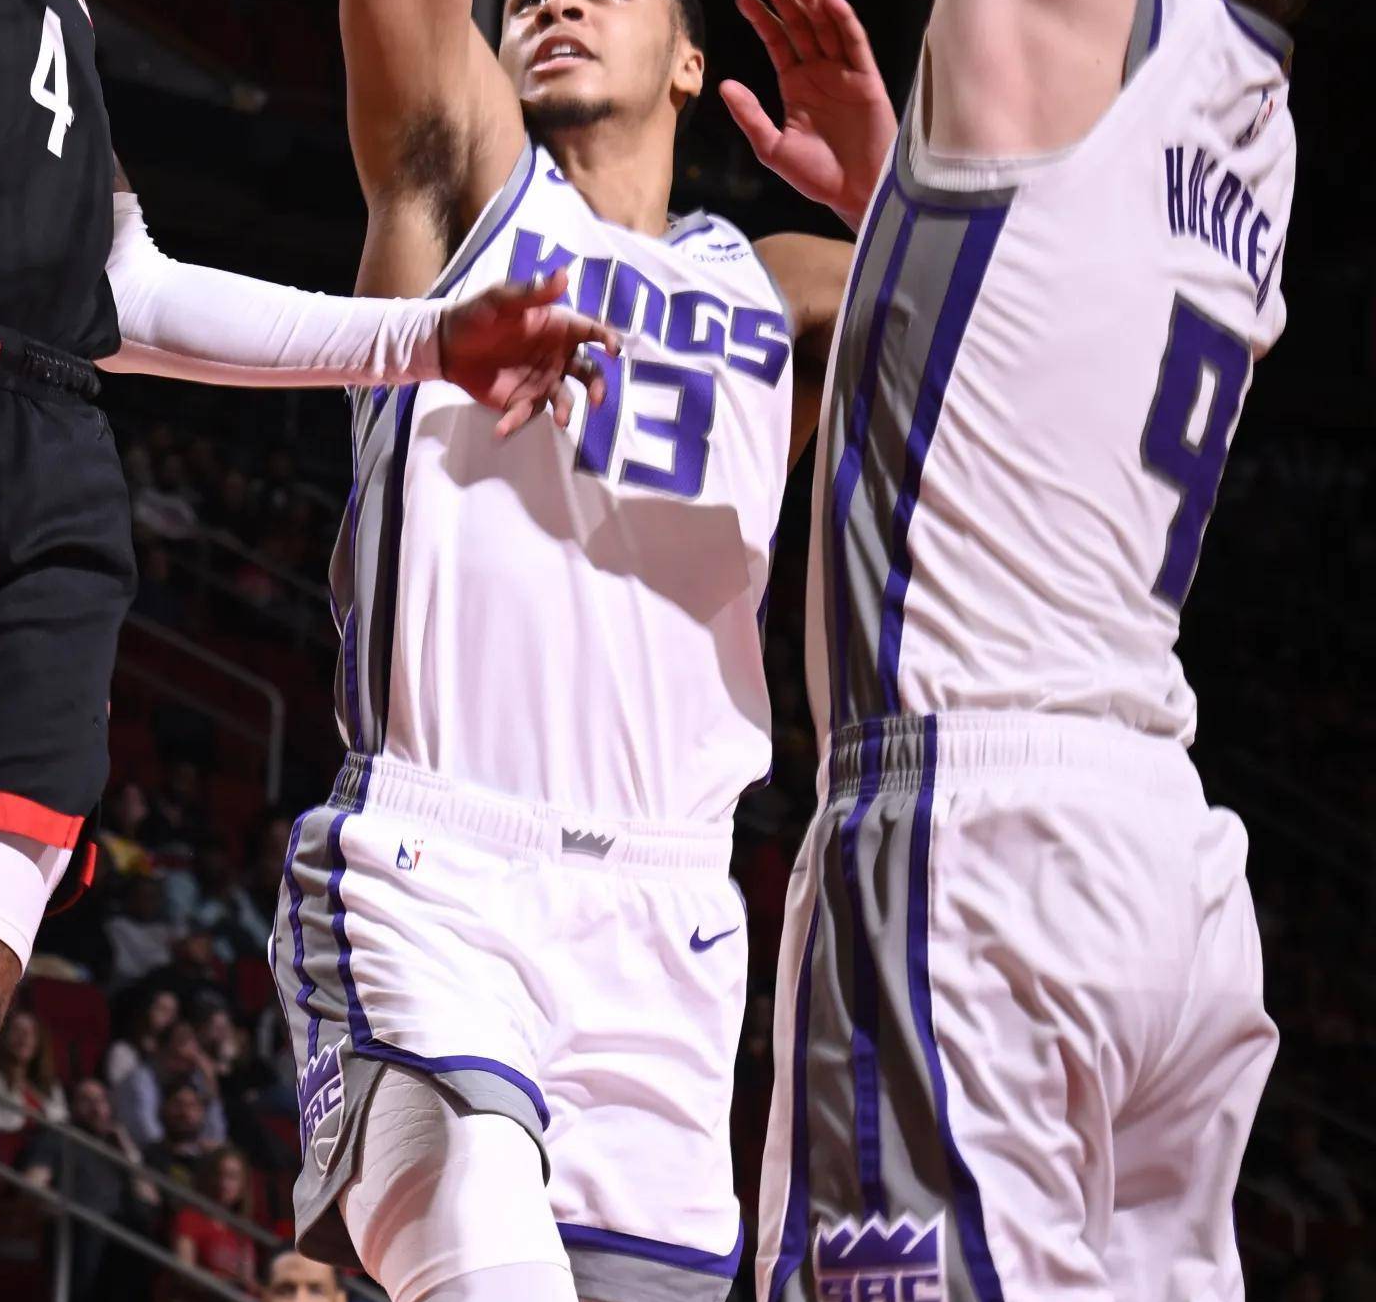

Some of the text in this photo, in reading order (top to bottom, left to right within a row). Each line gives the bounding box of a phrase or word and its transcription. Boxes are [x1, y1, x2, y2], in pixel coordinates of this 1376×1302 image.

[30, 5, 73, 159] 4
[574, 342, 714, 500] 13
[1139, 287, 1252, 614] 9
